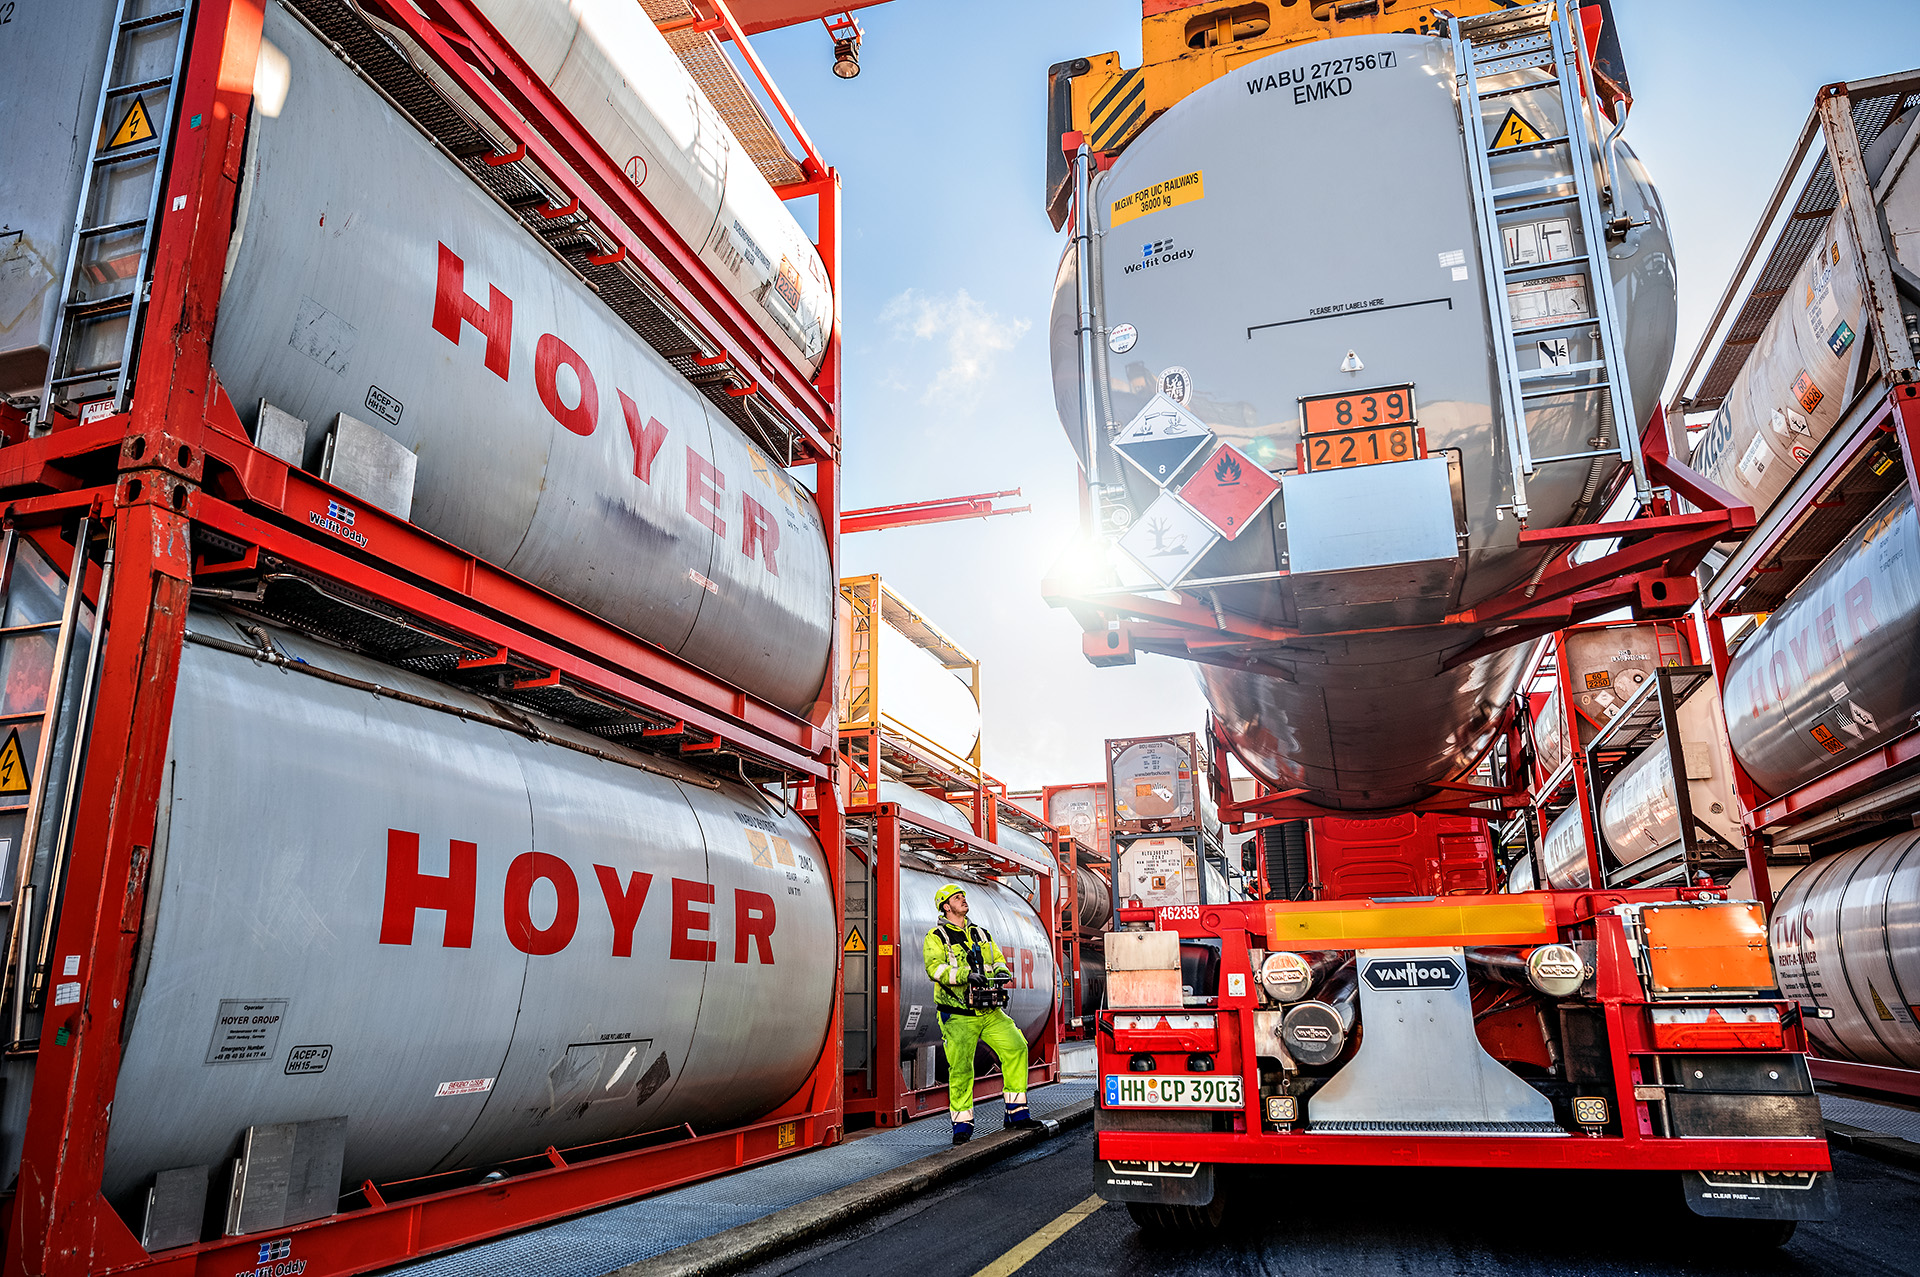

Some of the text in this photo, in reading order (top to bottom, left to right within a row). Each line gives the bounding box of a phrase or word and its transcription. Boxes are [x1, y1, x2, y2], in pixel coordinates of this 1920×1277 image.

[1247, 67, 1305, 95] WABU
[1311, 54, 1377, 80] 272756
[1294, 77, 1353, 105] EMKD
[1115, 172, 1199, 212] M.G.W. FOR UIC RAILWAYS
[1141, 195, 1172, 212] 36000 kg
[1124, 249, 1194, 274] Welfit Oddy
[778, 277, 798, 307] 2250
[1310, 298, 1384, 315] PLEASE PUT LABELS HERE
[1832, 328, 1850, 352] MTK
[1797, 379, 1807, 394] 60
[1803, 388, 1820, 410] 3428
[432, 240, 780, 577] HOYER
[1336, 393, 1404, 426] 839
[1314, 431, 1407, 466] 2218
[1158, 464, 1166, 474] 8
[310, 511, 368, 548] Welfit Oddy
[1227, 516, 1235, 526] 3
[1747, 577, 1880, 719] HOYER
[1549, 824, 1577, 868] HOYER
[379, 828, 777, 965] HOYER
[1161, 905, 1200, 920] 462353
[1775, 908, 1815, 950] TWS
[221, 1015, 280, 1025] HOYER GROUP
[1110, 1092, 1116, 1100] D
[1120, 1079, 1240, 1103] HH CP 3903
[275, 1259, 307, 1275] Oddy
